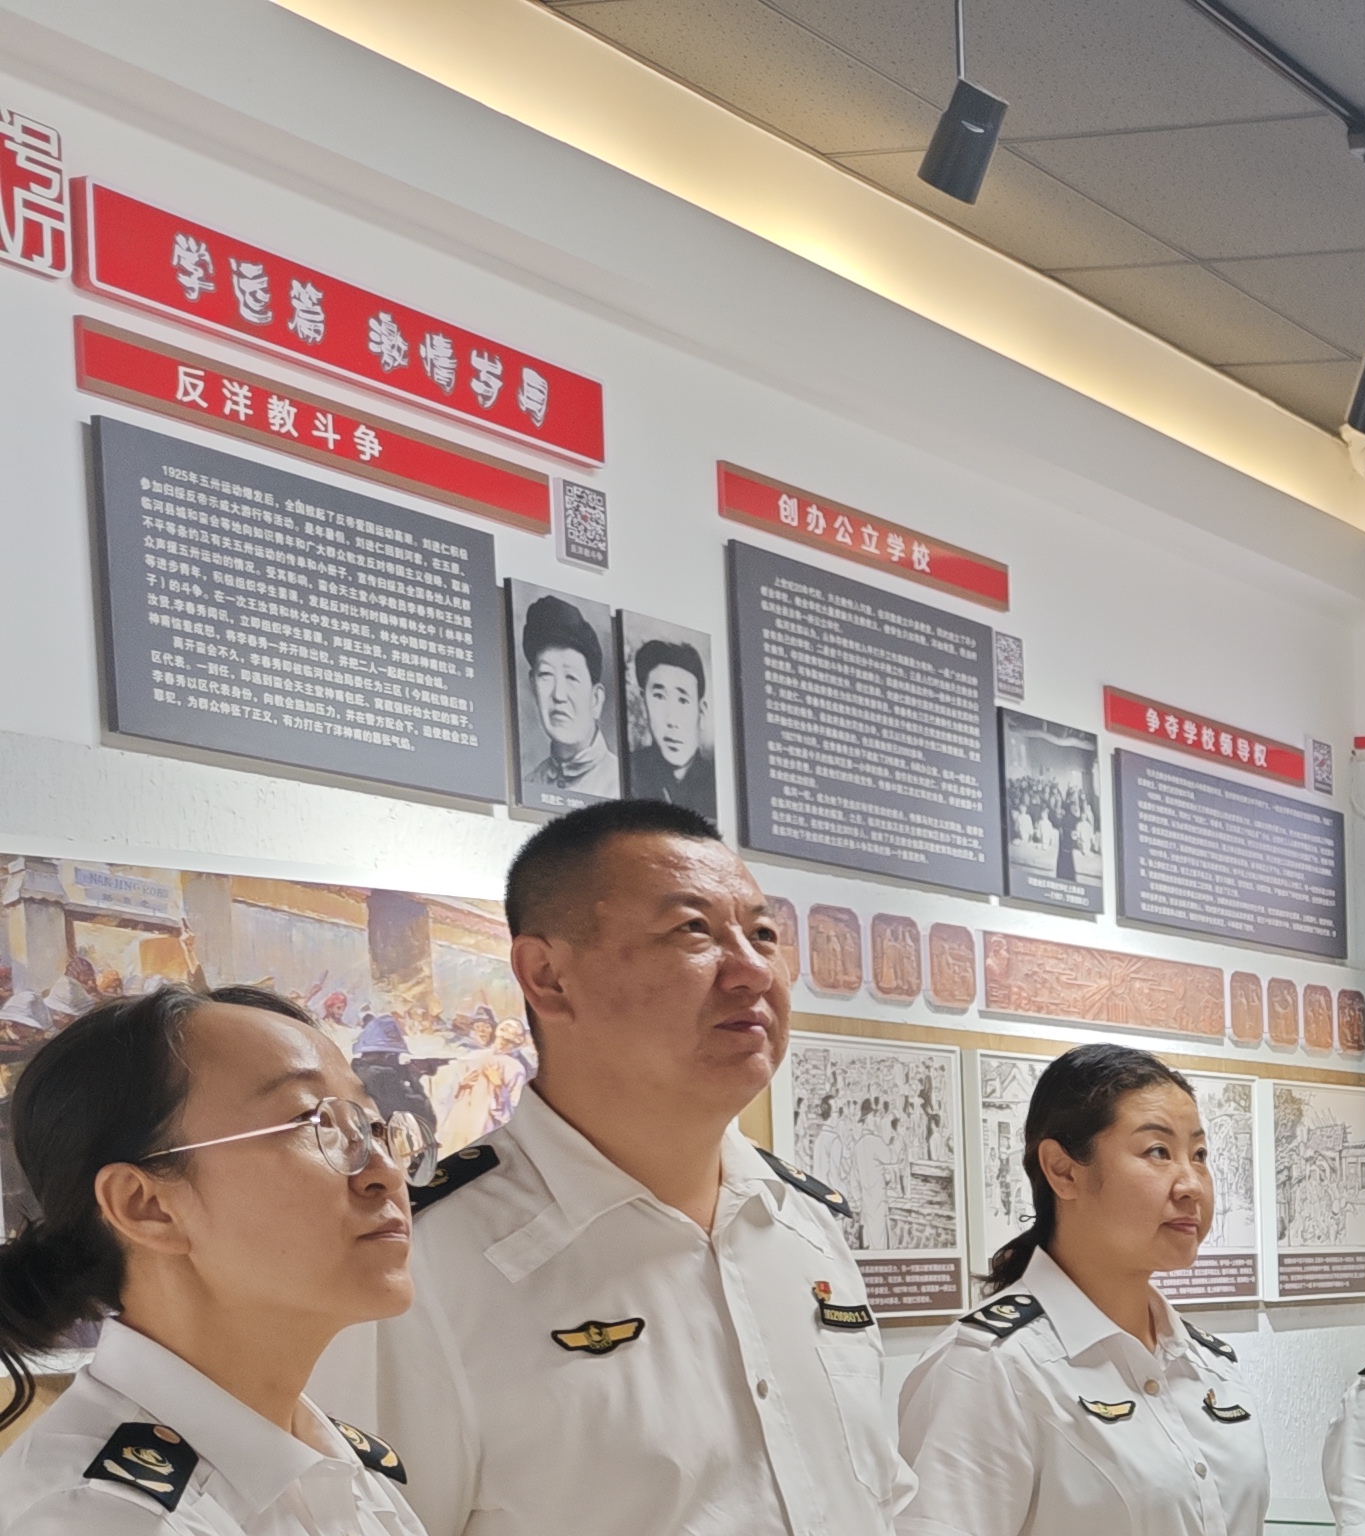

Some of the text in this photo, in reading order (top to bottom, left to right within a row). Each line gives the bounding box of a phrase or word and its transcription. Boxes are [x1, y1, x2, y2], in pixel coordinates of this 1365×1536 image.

[175, 366, 383, 462] 反洋教斗争
[778, 494, 931, 574] 创办公立学校
[1145, 707, 1268, 768] 争夺学校领导权
